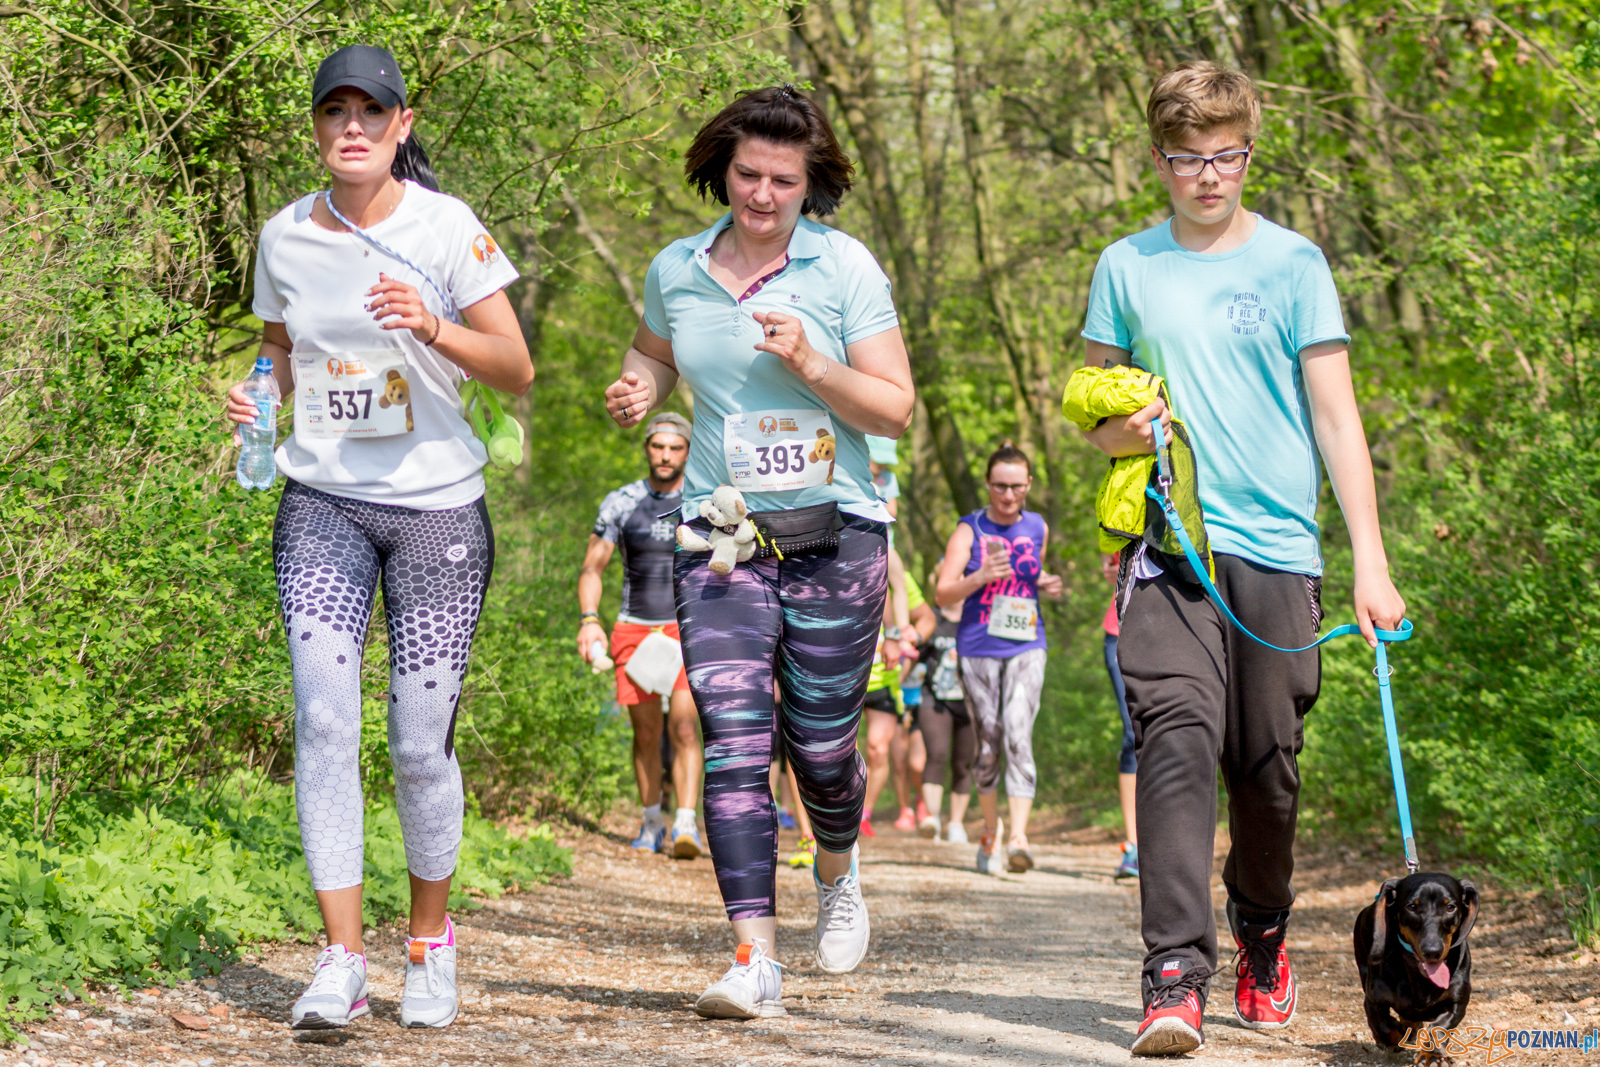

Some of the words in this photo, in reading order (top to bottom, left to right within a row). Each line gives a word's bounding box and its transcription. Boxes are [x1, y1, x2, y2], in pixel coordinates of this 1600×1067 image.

[1233, 292, 1261, 305] ORIGINAL
[1227, 305, 1234, 319] 19
[1231, 323, 1241, 334] TOM
[1242, 325, 1260, 335] TAILOR
[328, 388, 373, 420] 537
[755, 444, 805, 476] 393
[1005, 614, 1028, 630] 356
[1162, 960, 1180, 971] NIKE
